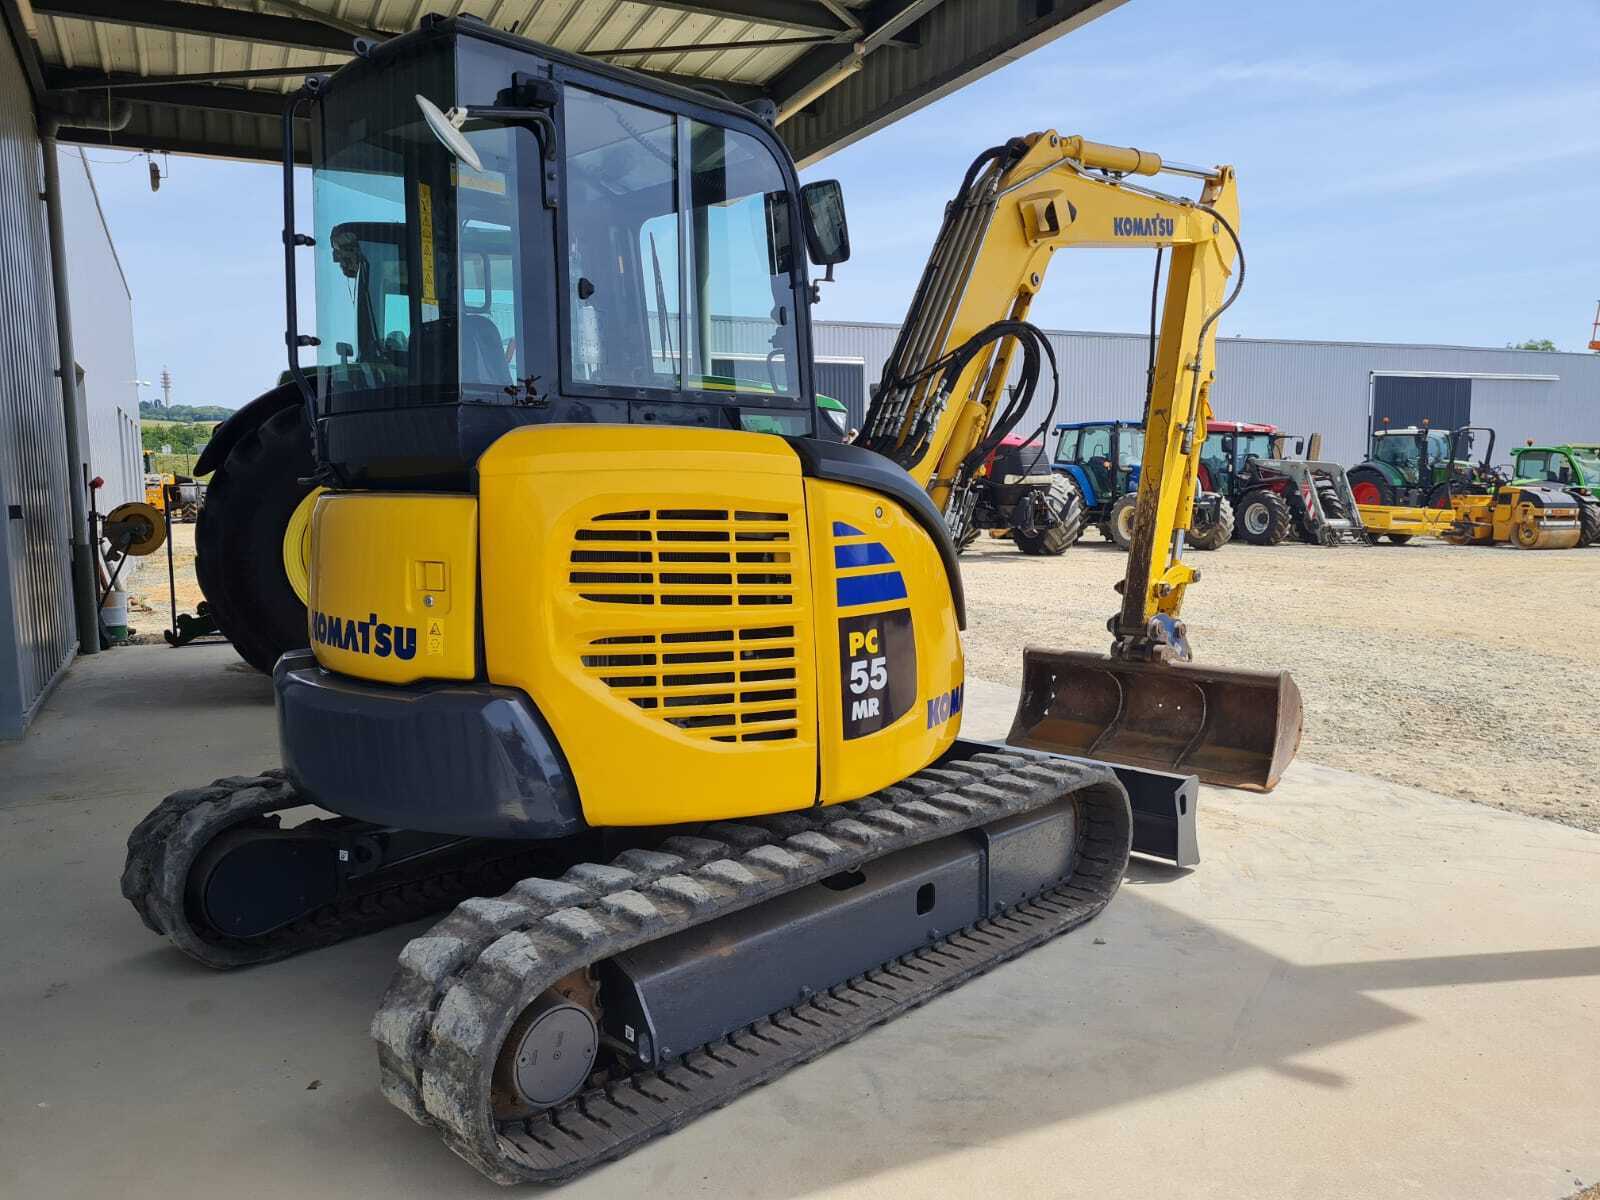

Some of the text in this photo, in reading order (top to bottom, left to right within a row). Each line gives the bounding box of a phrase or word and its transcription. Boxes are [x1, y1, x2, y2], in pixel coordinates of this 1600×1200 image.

[1113, 213, 1174, 236] KOMATSU
[848, 628, 879, 657] PC
[849, 656, 888, 695] 55
[851, 697, 880, 721] MR
[927, 682, 965, 729] KOM
